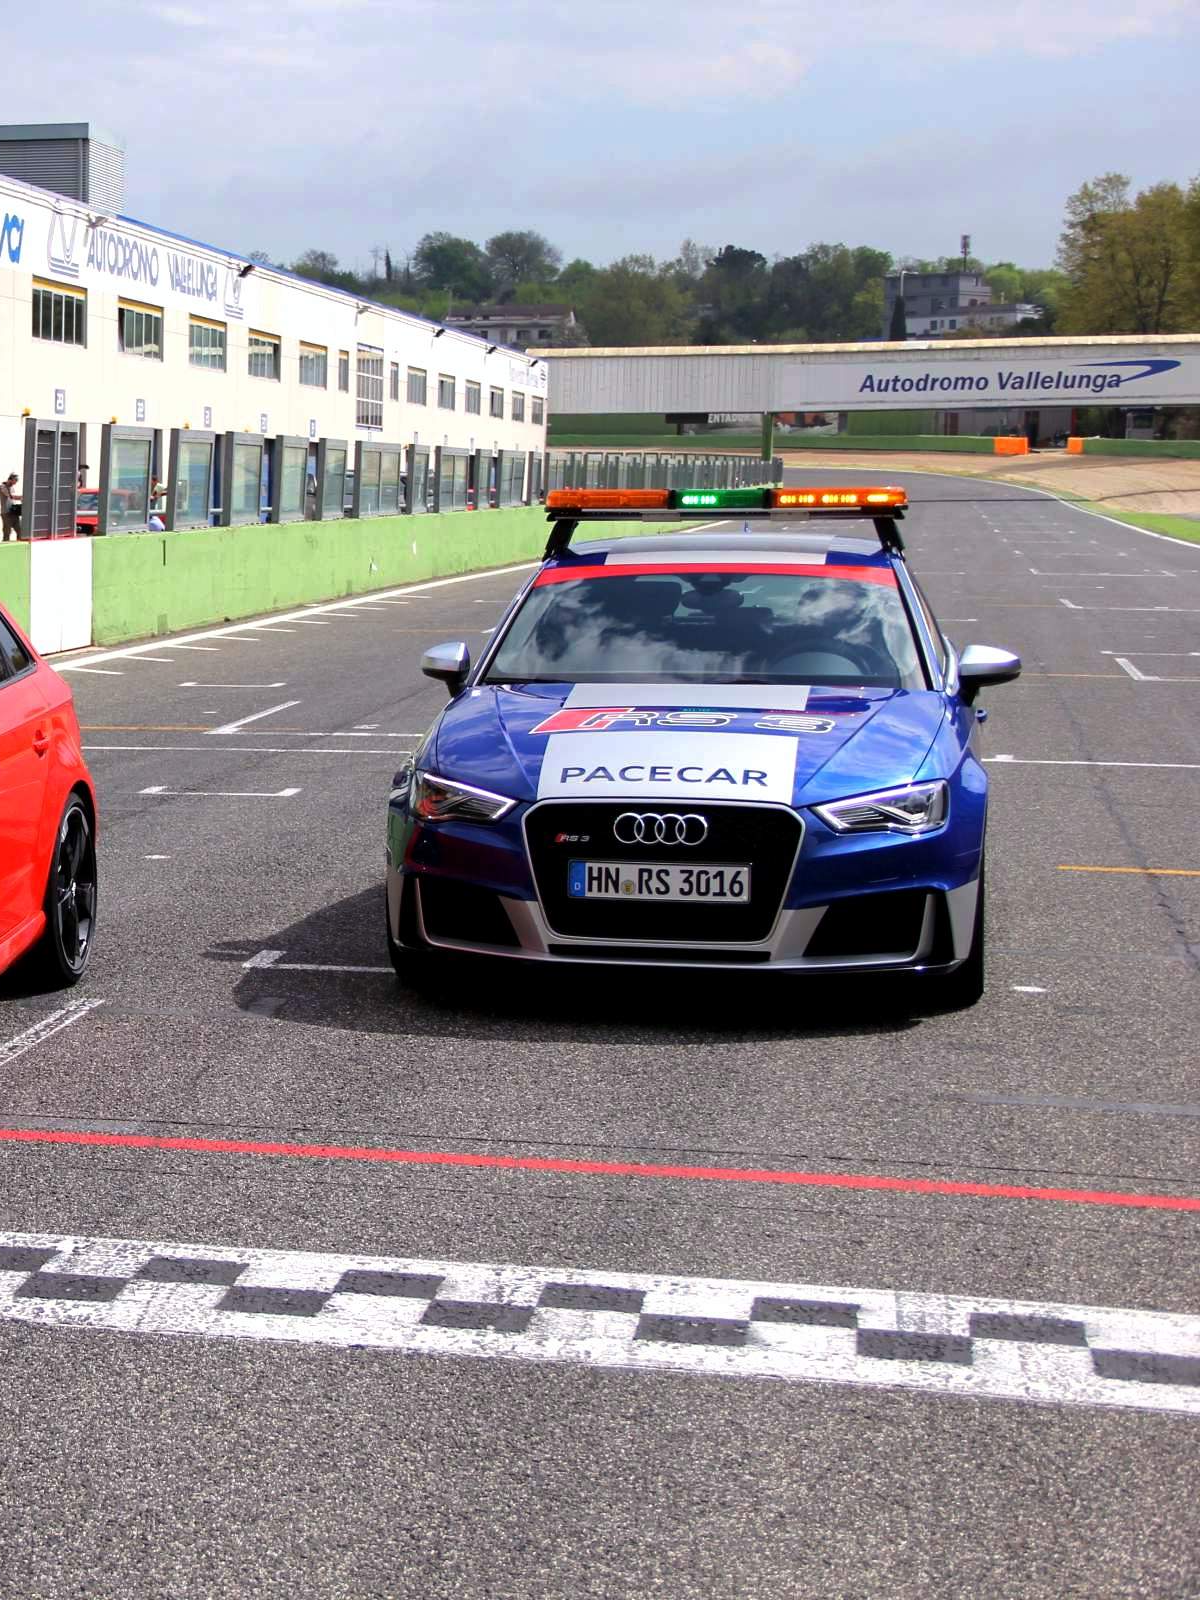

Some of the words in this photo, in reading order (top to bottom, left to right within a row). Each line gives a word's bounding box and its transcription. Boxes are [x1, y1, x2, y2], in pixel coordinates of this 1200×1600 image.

[86, 225, 159, 287] AUTODROMO
[859, 373, 990, 393] Autodromo
[997, 371, 1122, 393] Vallelunga
[559, 765, 769, 788] PACECAR
[586, 866, 620, 894] HN
[637, 868, 671, 896] RS
[678, 869, 745, 898] 3016
